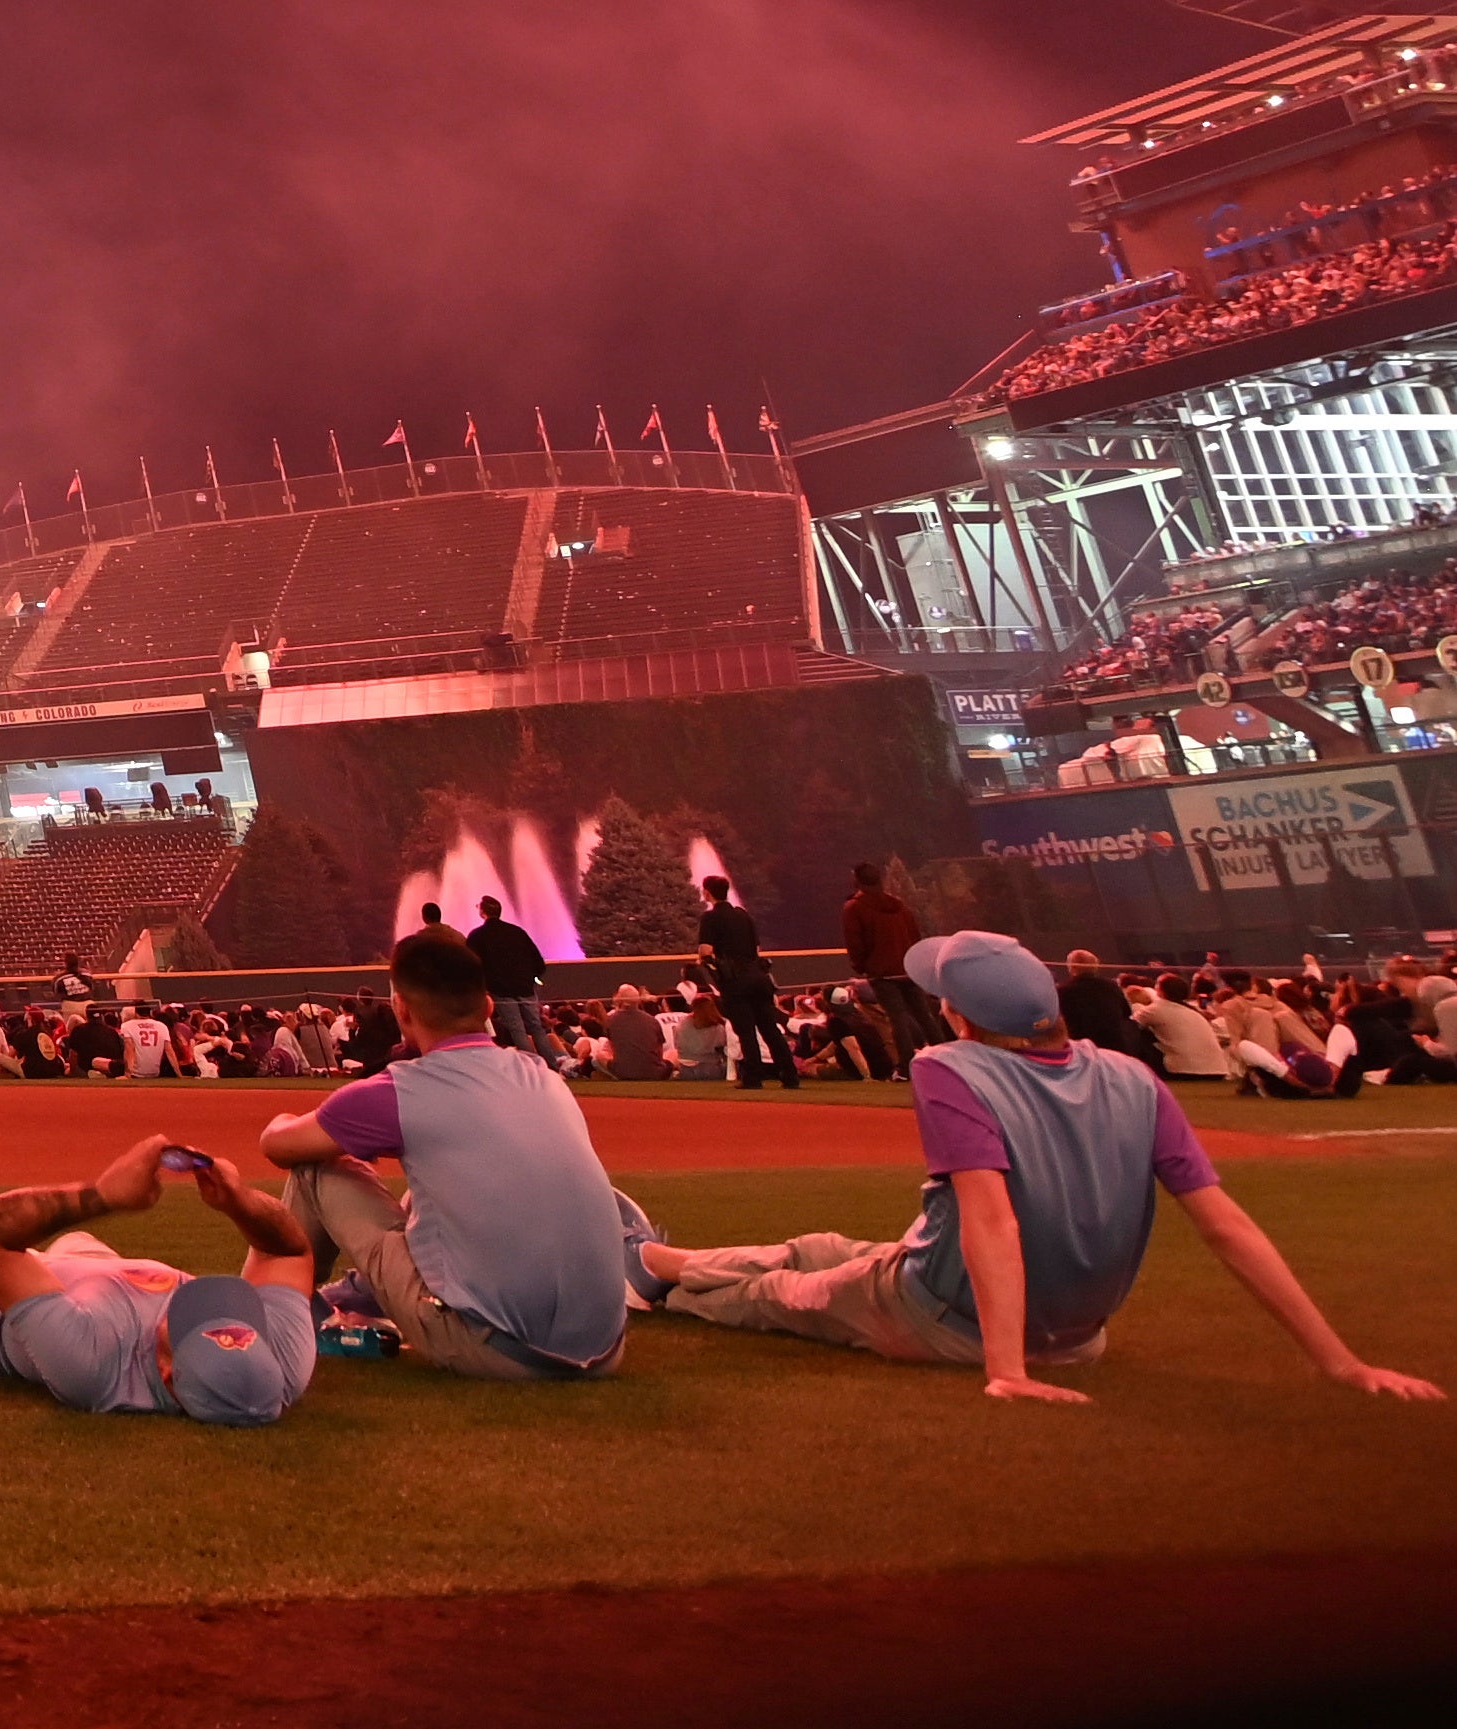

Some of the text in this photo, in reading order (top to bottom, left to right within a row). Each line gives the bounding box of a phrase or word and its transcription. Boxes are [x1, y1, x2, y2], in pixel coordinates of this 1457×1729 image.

[35, 704, 97, 721] COLORADO
[1215, 785, 1338, 821] BACHUS
[981, 826, 1147, 868] Southwest
[1190, 815, 1350, 852] SCHANKER
[1214, 853, 1278, 877] INJUR
[139, 1030, 159, 1047] 27
